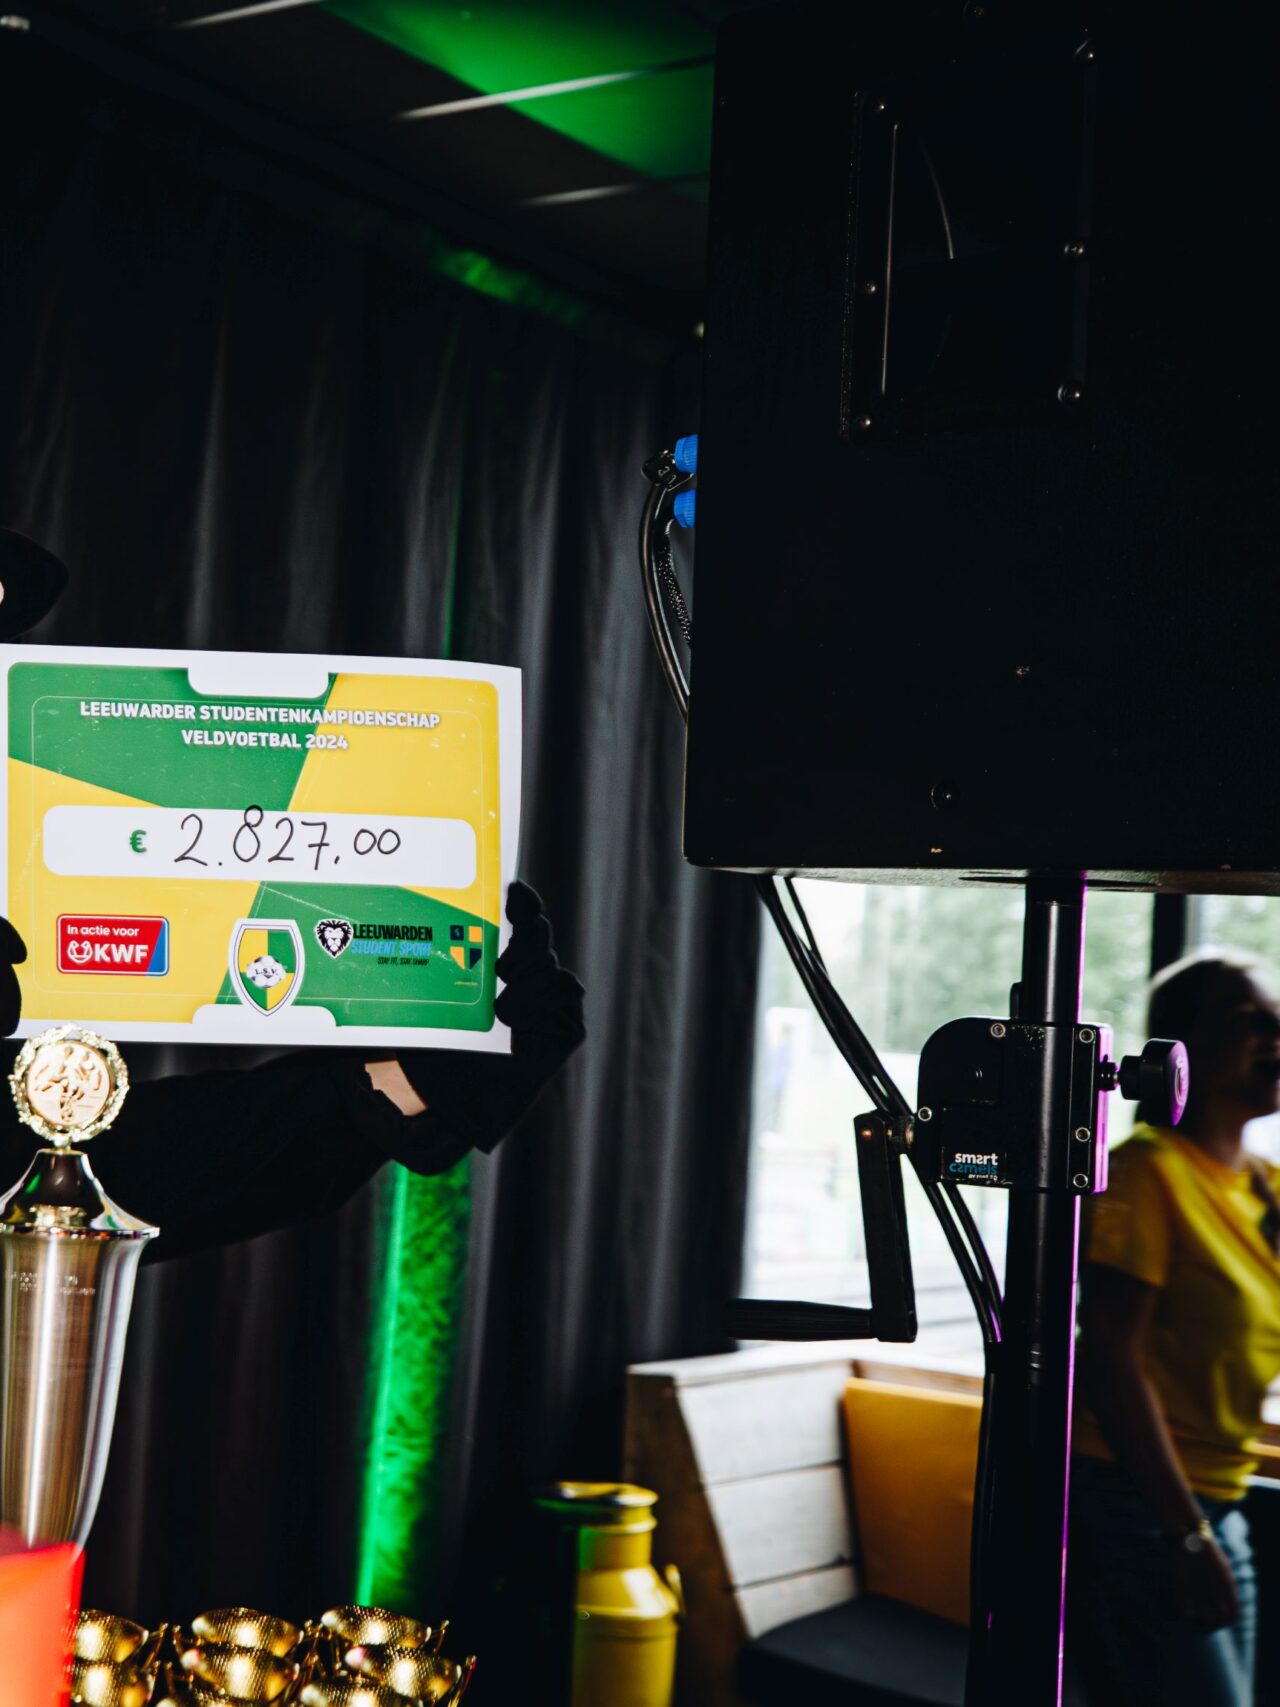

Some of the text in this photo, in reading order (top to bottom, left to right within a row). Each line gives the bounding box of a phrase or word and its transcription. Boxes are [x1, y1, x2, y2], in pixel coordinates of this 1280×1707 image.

[80, 701, 440, 728] LEEUWARDER STUDENTENKAMPIOENSCHAP
[181, 729, 349, 750] VELDVOETBAL 2024
[129, 829, 147, 854] €
[66, 924, 140, 936] In actie voor
[353, 923, 433, 941] LEEUWARDEN
[94, 943, 149, 963] KWF
[351, 940, 396, 956] STUDENT
[954, 1152, 999, 1166] smart
[948, 1162, 998, 1175] camels
